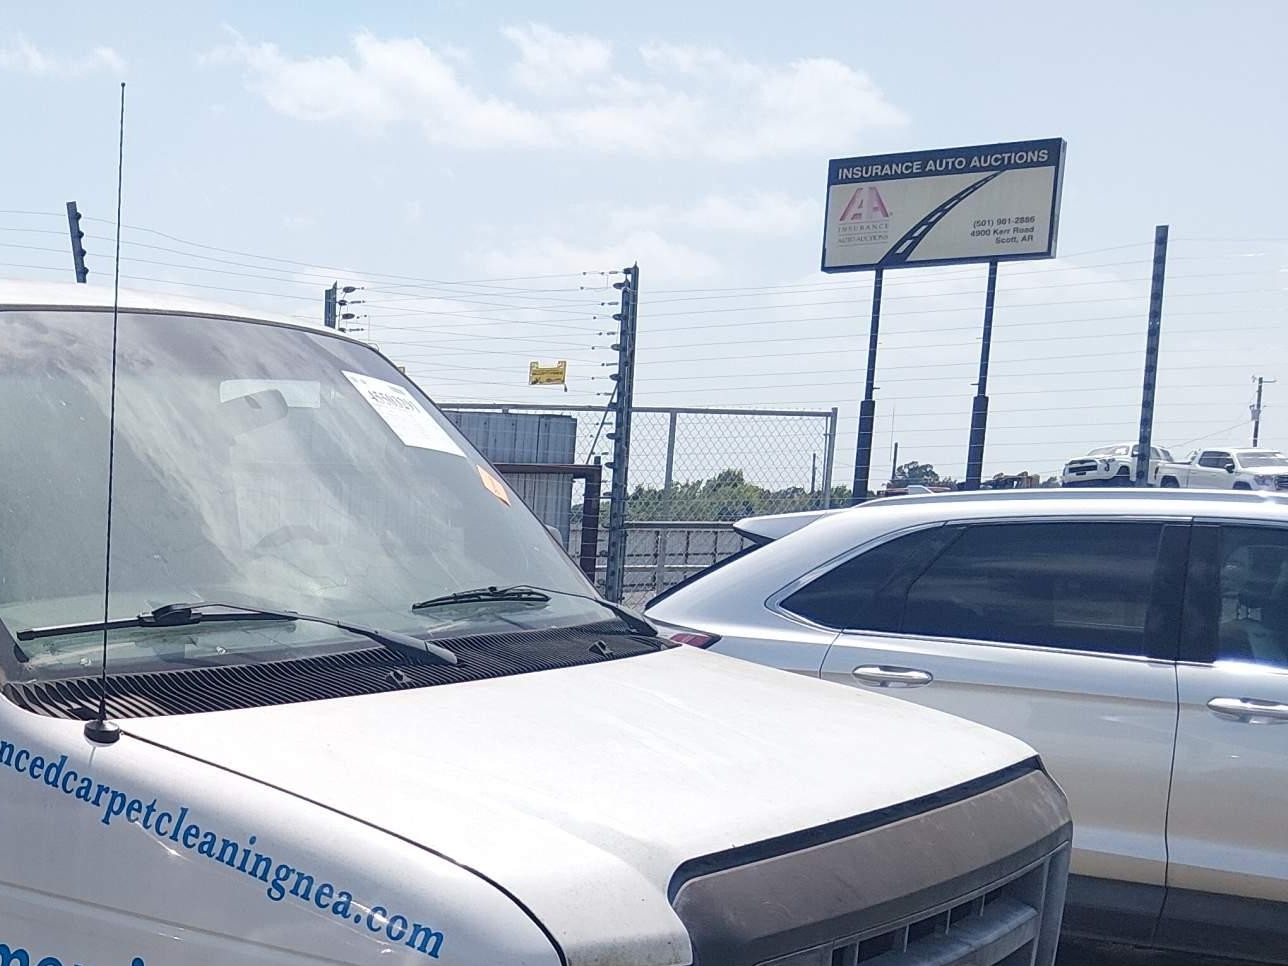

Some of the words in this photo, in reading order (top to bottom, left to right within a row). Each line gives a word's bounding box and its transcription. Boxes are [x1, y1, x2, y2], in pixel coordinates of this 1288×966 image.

[838, 161, 922, 179] INSURANCE
[925, 157, 966, 172] AUTO
[971, 150, 1049, 167] AUCTIONS
